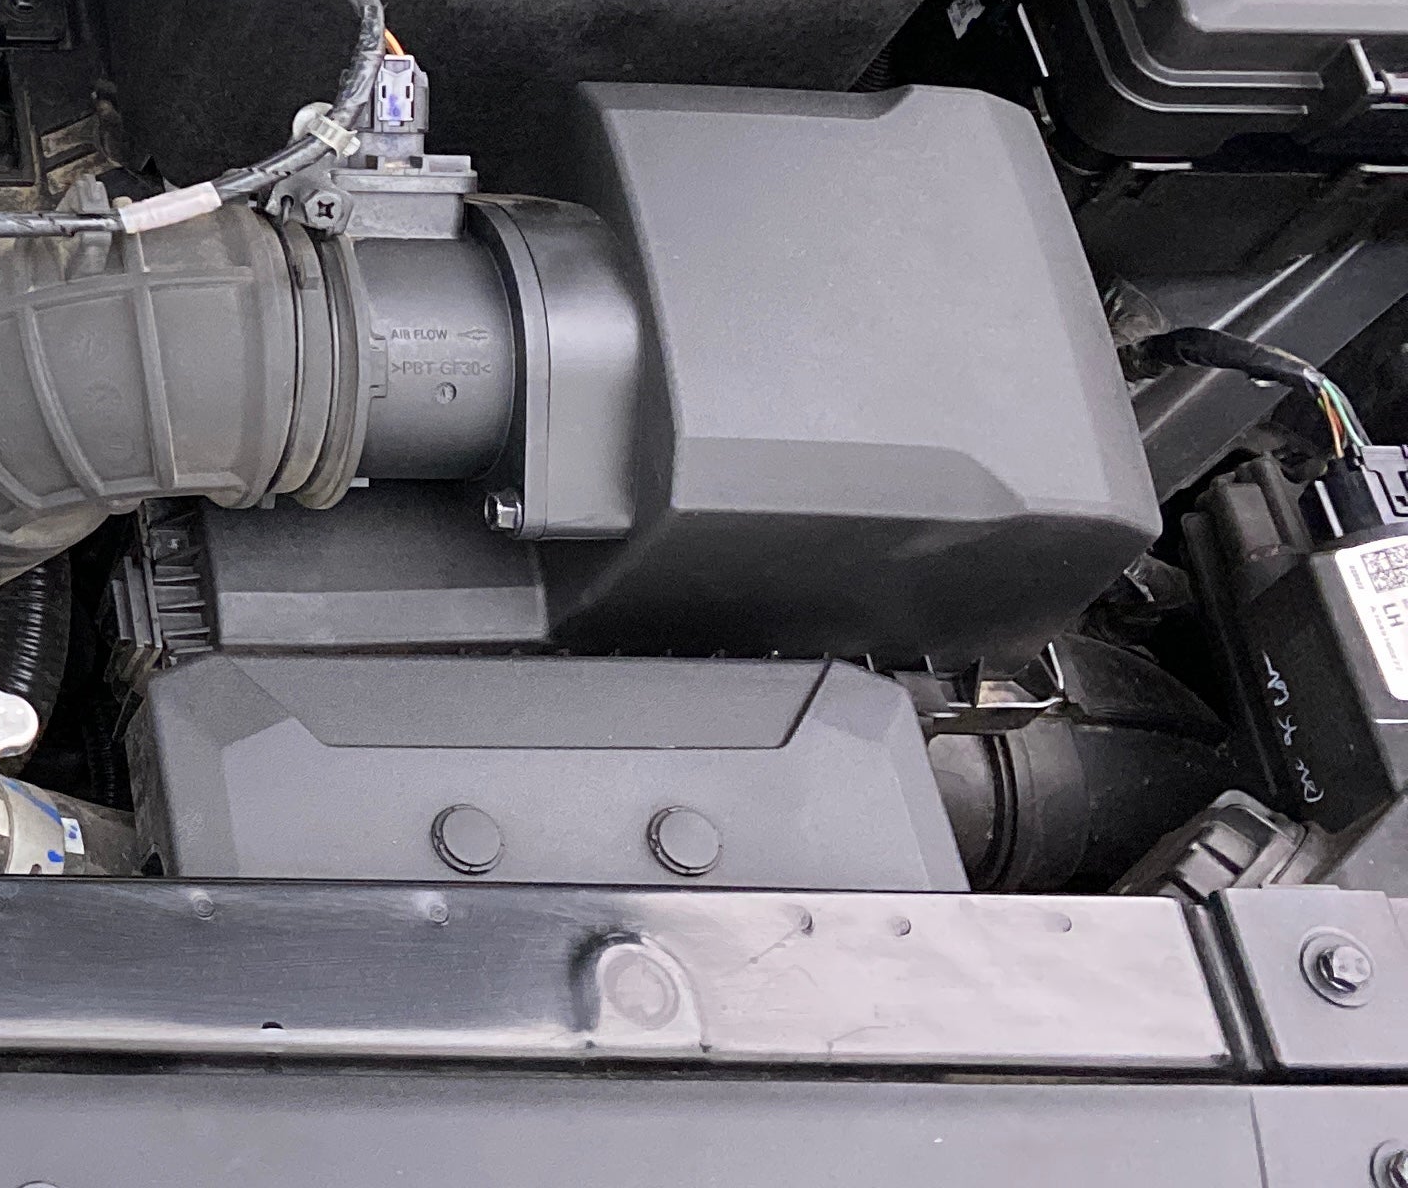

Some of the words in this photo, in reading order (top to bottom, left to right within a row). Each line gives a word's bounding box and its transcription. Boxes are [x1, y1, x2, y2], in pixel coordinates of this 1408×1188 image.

[391, 328, 411, 341] AIR
[413, 328, 448, 341] FLOW
[1382, 602, 1405, 628] LH
